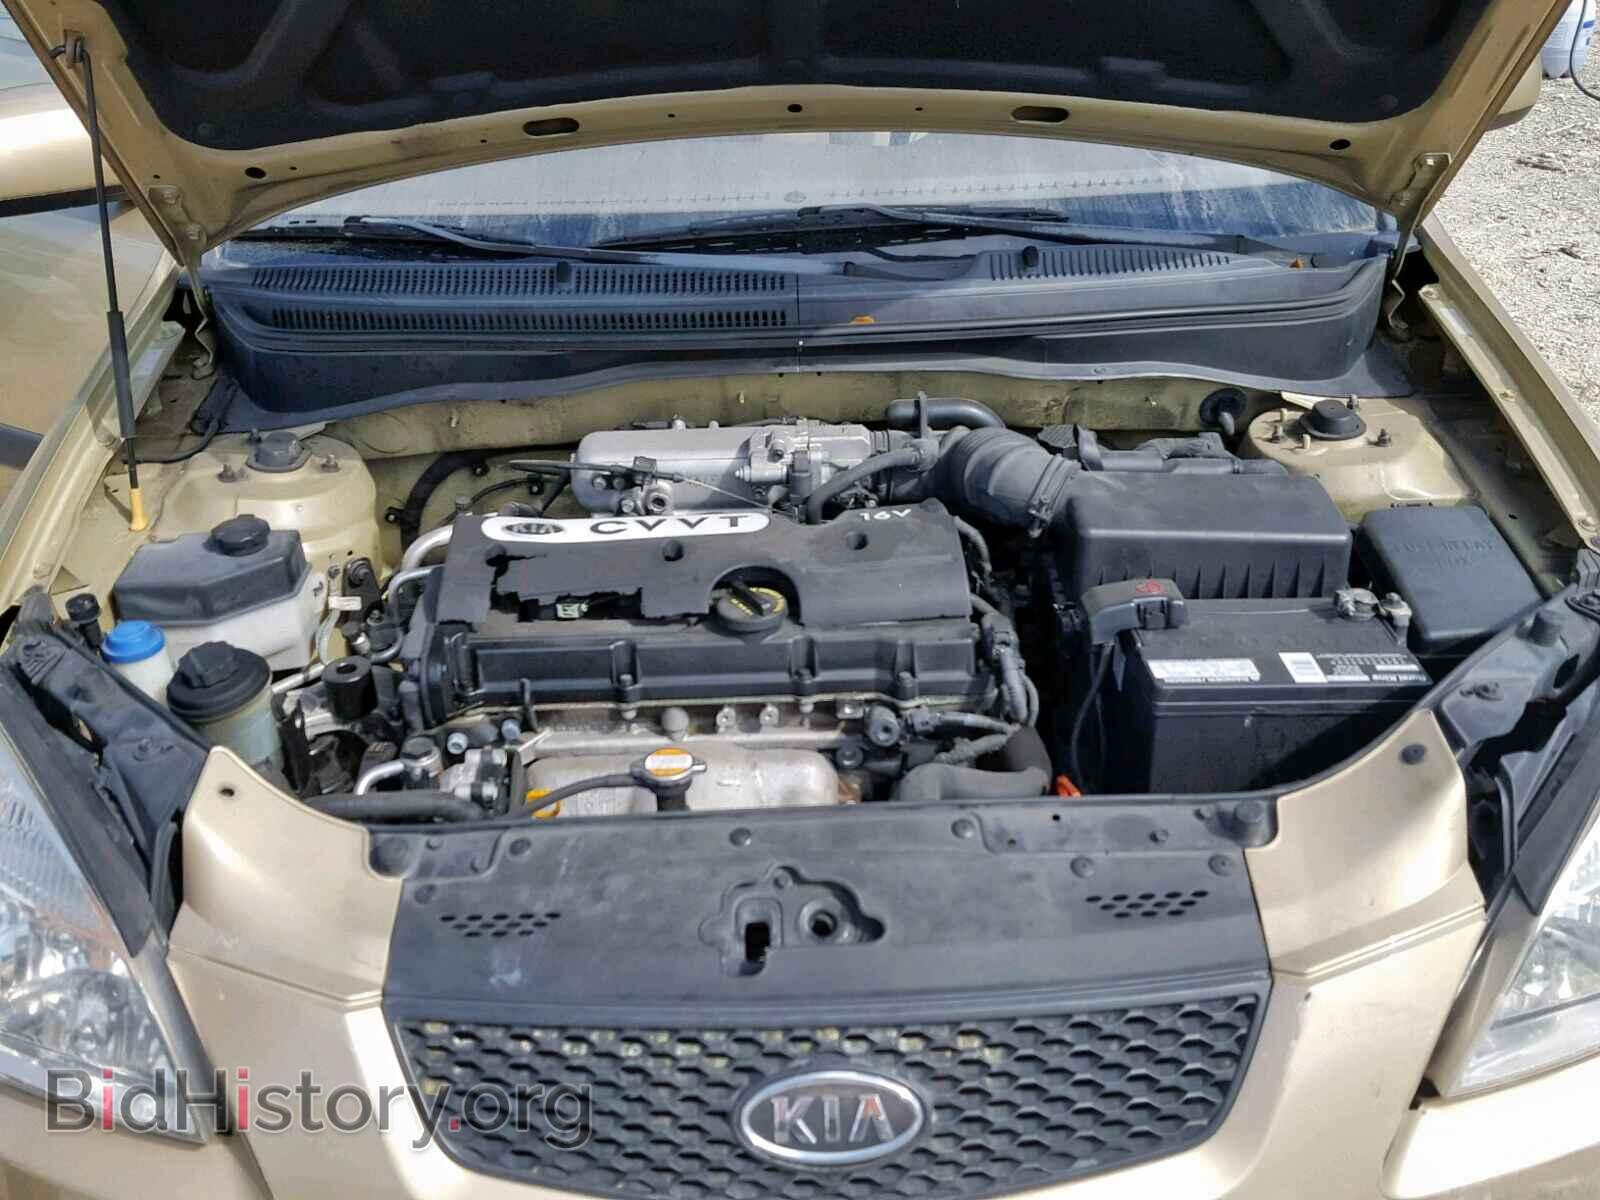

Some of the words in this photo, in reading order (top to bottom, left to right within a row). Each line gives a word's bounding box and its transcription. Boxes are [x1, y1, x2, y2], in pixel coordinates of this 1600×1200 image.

[859, 508, 912, 521] 16V
[589, 515, 748, 535] CVVT
[771, 1093, 896, 1145] KIA
